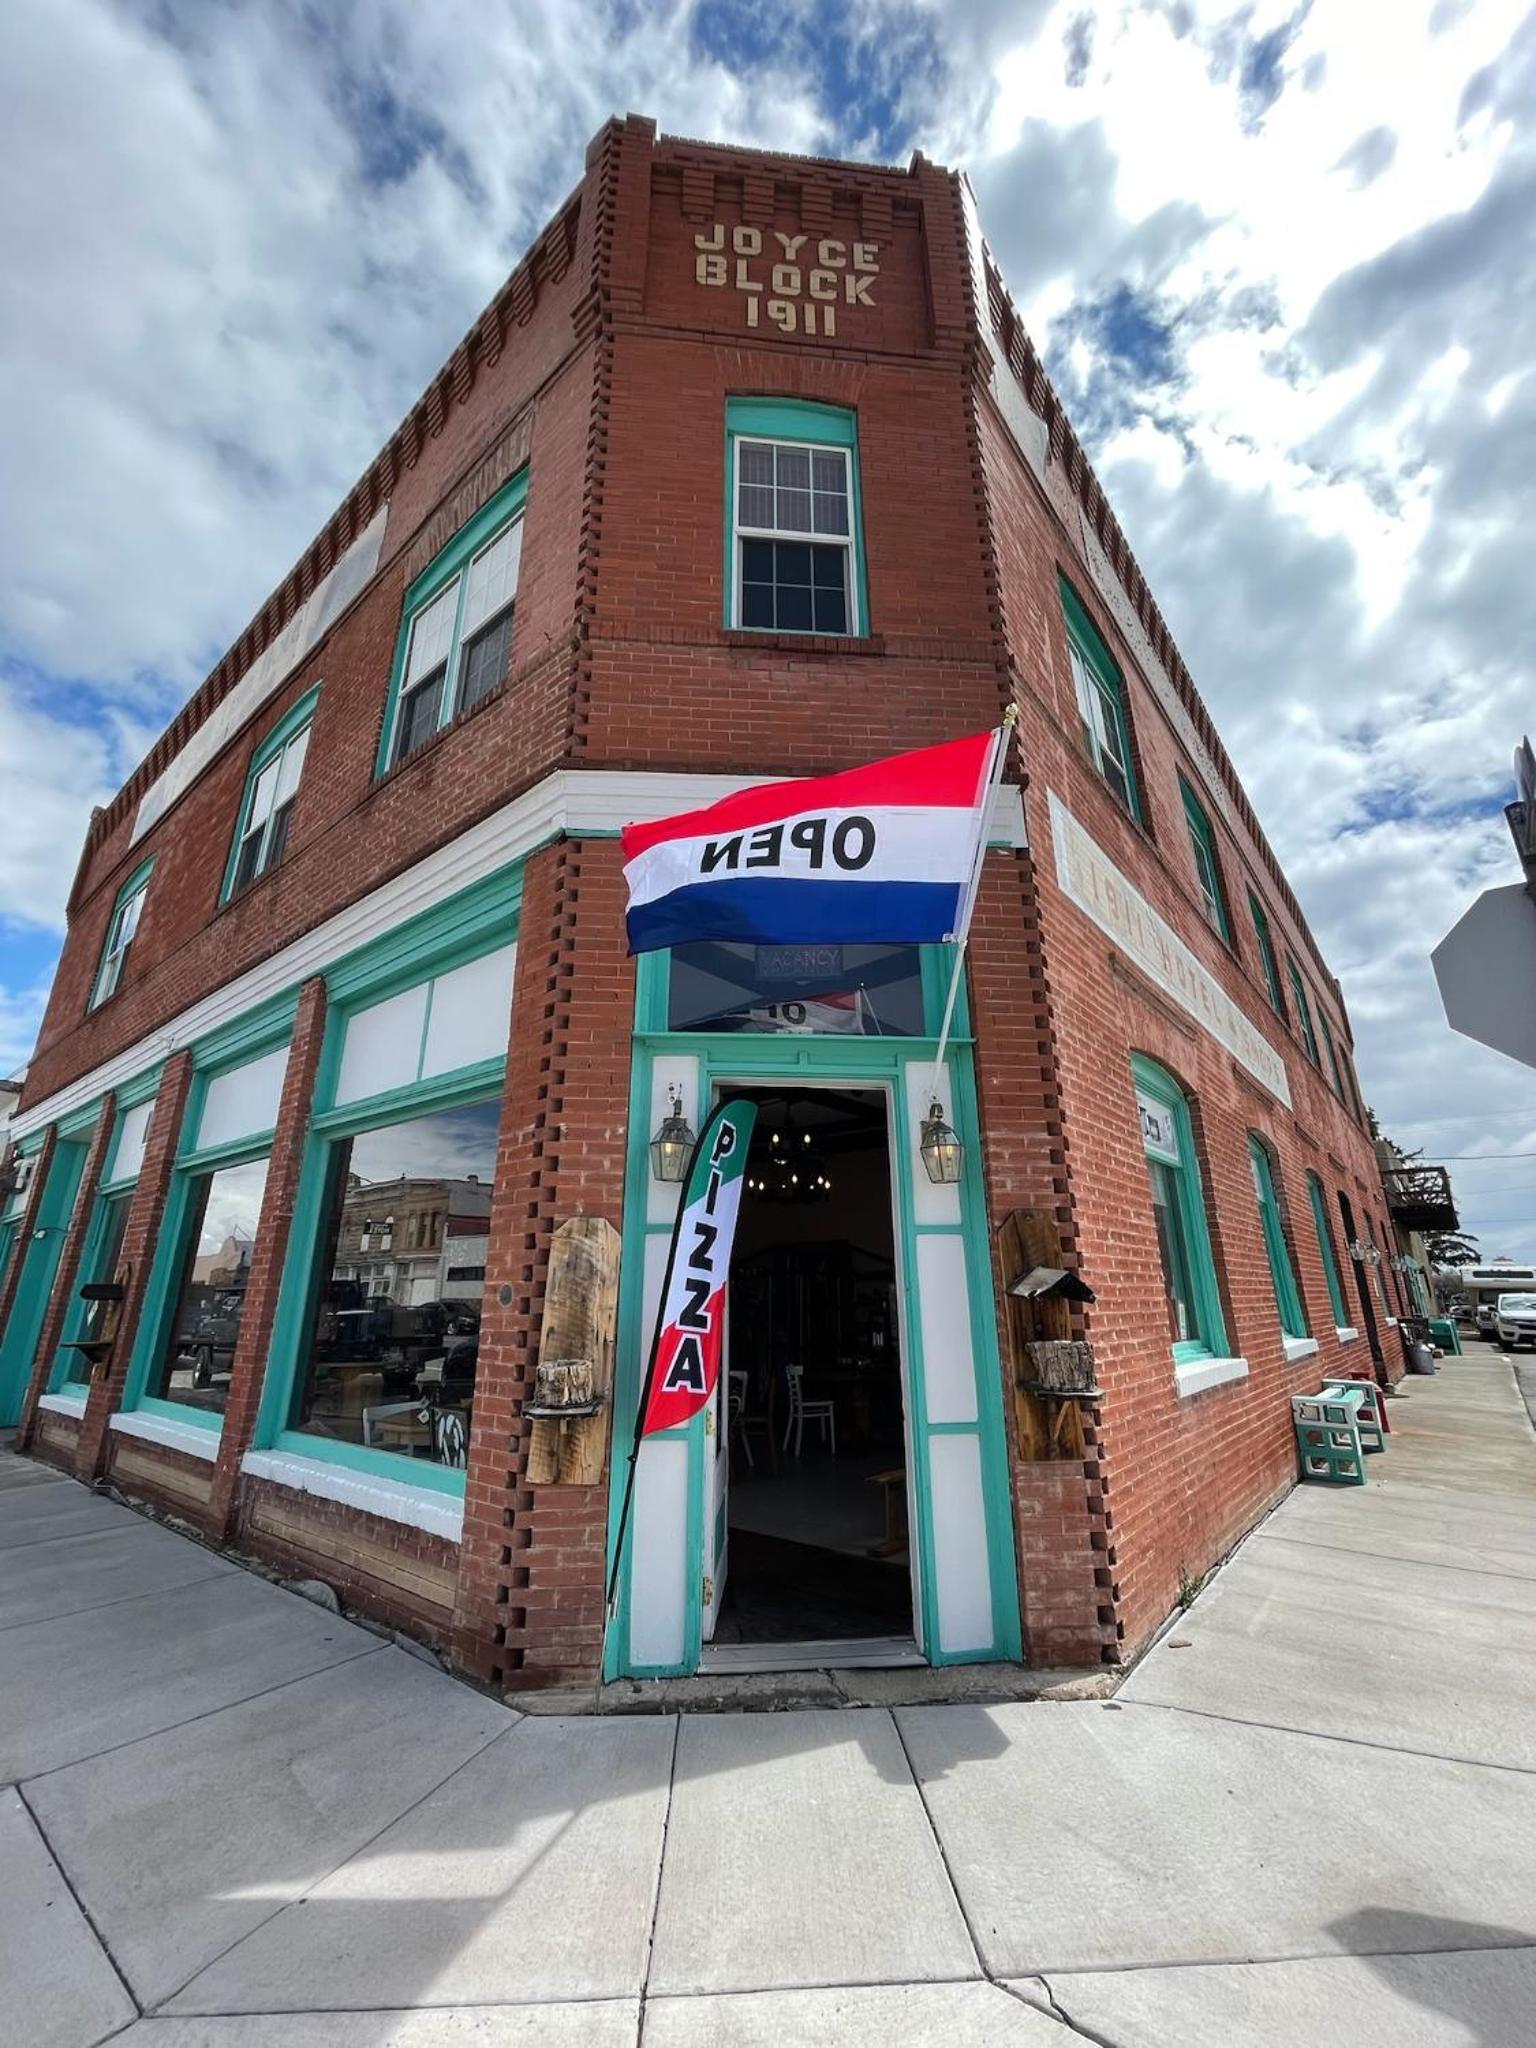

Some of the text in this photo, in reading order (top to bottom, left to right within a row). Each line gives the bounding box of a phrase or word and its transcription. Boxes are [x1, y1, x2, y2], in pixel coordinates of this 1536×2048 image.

[695, 223, 880, 272] JOYCE
[696, 253, 877, 306] BLOCK
[746, 296, 836, 337] 1911
[759, 949, 839, 969] ACANCY
[663, 1119, 738, 1394] PIZZA
